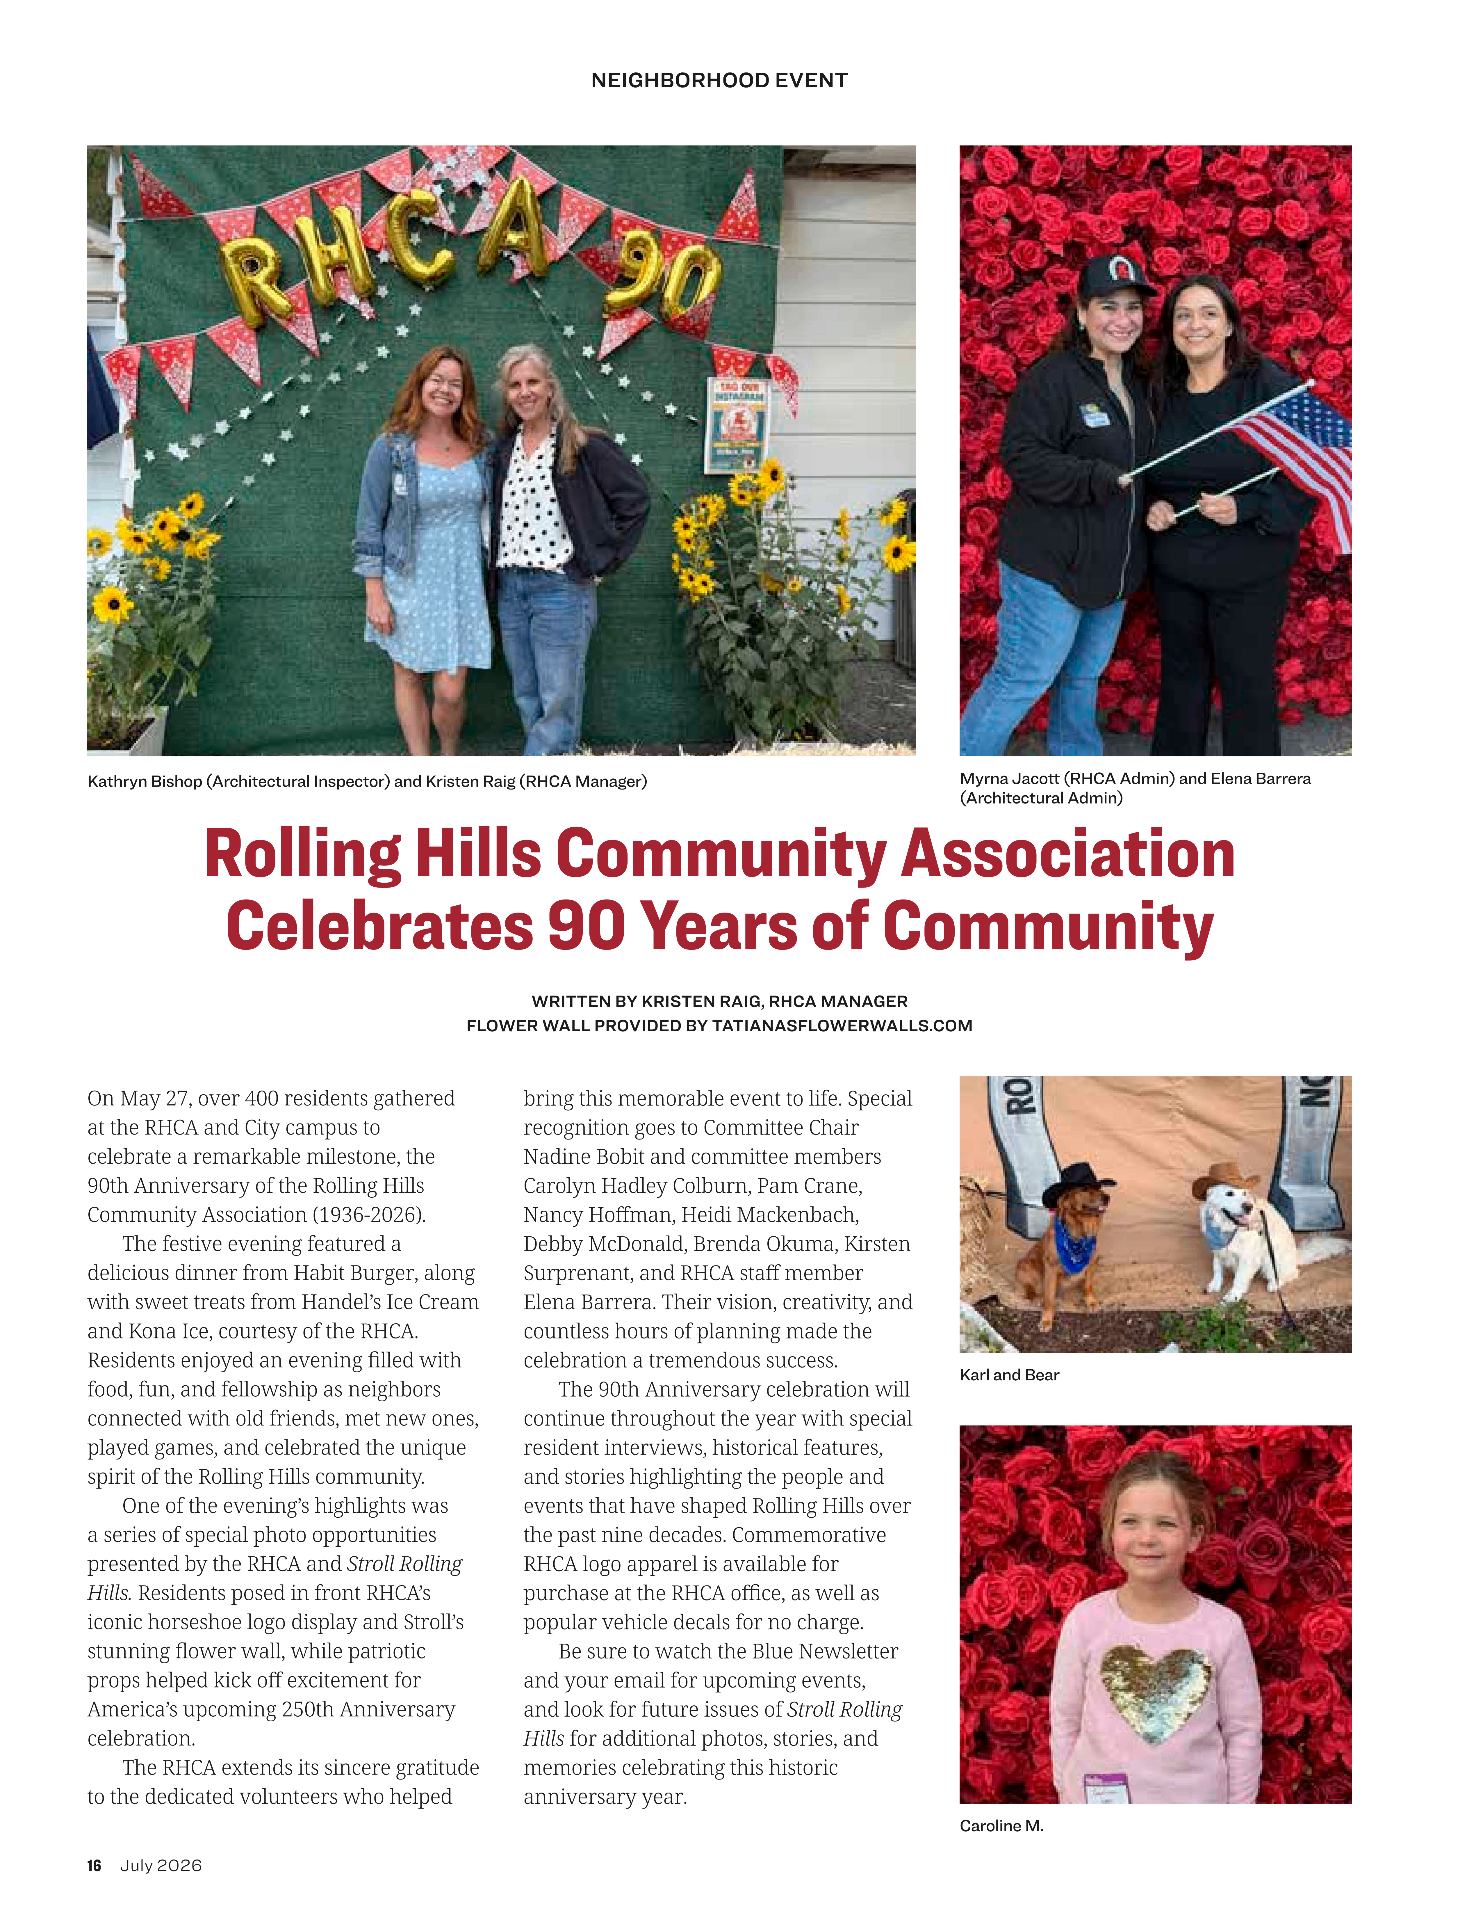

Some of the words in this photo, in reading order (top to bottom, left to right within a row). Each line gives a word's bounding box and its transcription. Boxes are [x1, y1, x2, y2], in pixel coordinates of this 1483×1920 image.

[593, 72, 769, 88] NEIGHBORHOOD
[776, 73, 848, 87] EVENT
[220, 174, 549, 329] RHCA
[602, 230, 724, 320] 90
[89, 775, 147, 790] Kathryn
[152, 775, 202, 790] Bishop
[207, 773, 309, 790] (Architectural
[315, 774, 390, 790] Inspector)
[395, 775, 421, 787] and
[427, 775, 478, 787] Kristen
[484, 775, 515, 790] Raig
[520, 774, 571, 790] (RHCA
[576, 774, 647, 790] Manager)
[961, 773, 1008, 787] Myrna
[1012, 773, 1060, 784] Jacott
[1064, 771, 1116, 787] (RHCA
[1120, 771, 1175, 787] Admin)
[1180, 772, 1206, 784] and
[1212, 772, 1252, 784] Elena
[1257, 773, 1311, 784] Barrera
[961, 790, 1063, 806] (Architectural
[1068, 790, 1122, 806] Admin)
[207, 826, 401, 888] Rolling
[418, 826, 541, 877] Hills
[558, 827, 887, 888] Community
[901, 827, 1234, 877] Association
[228, 898, 533, 950] Celebrates
[549, 899, 624, 950] 90
[640, 900, 797, 950] Years
[813, 898, 869, 950] of
[885, 899, 1214, 961] Community
[532, 996, 610, 1007] WRITTEN
[616, 996, 637, 1007] BY
[643, 995, 714, 1007] KRISTEN
[721, 995, 764, 1010] RAIG,
[770, 995, 816, 1007] RHCA
[822, 995, 907, 1007] MANAGER
[468, 1020, 537, 1032] FLOWER
[543, 1020, 590, 1031] WALL
[595, 1020, 681, 1032] PROVIDED
[687, 1020, 708, 1031] BY
[712, 1020, 972, 1032] TATIANASFLOWERWALLS.COM
[88, 1090, 114, 1106] On
[121, 1091, 161, 1110] May
[167, 1090, 192, 1108] 27,
[199, 1094, 240, 1106] over
[245, 1090, 278, 1106] 400
[285, 1090, 367, 1106] residents
[374, 1090, 455, 1110] gathered
[524, 1119, 629, 1140] recognition
[635, 1123, 675, 1140] goes
[681, 1121, 697, 1135] to
[704, 1119, 803, 1135] Committee
[810, 1119, 859, 1135] Chair
[88, 1177, 129, 1193] 90th
[134, 1177, 249, 1198] Anniversary
[256, 1177, 275, 1193] of
[279, 1177, 307, 1193] the
[313, 1177, 377, 1198] Rolling
[383, 1177, 424, 1193] Hills
[524, 1207, 583, 1227] Nancy
[589, 1206, 675, 1225] Hoffman,
[682, 1206, 732, 1222] Heidi
[737, 1206, 858, 1225] Mackenbach,
[88, 1264, 169, 1280] delicious
[176, 1264, 237, 1280] dinner
[243, 1264, 288, 1280] from
[294, 1264, 344, 1280] Habit
[351, 1265, 418, 1285] Burger,
[425, 1264, 475, 1285] along
[524, 1293, 575, 1309] Elena
[582, 1294, 655, 1309] Barrera.
[662, 1293, 711, 1309] Their
[717, 1294, 776, 1312] vision,
[783, 1294, 871, 1314] creativity,
[878, 1293, 913, 1309] and
[89, 1352, 175, 1368] Residents
[182, 1352, 253, 1372] enjoyed
[260, 1356, 281, 1368] an
[289, 1352, 362, 1372] evening
[368, 1351, 413, 1368] filled
[419, 1352, 460, 1368] with
[961, 1369, 989, 1381] Karl
[994, 1369, 1020, 1381] and
[1026, 1369, 1060, 1381] Bear
[559, 1381, 592, 1397] The
[599, 1381, 639, 1397] 90th
[645, 1381, 761, 1402] Anniversary
[767, 1381, 869, 1397] celebration
[875, 1381, 910, 1397] will
[88, 1439, 149, 1460] played
[155, 1443, 217, 1460] games,
[224, 1439, 259, 1455] and
[265, 1439, 360, 1455] celebrated
[366, 1439, 394, 1455] the
[401, 1439, 466, 1460] unique
[524, 1468, 559, 1484] and
[565, 1468, 624, 1484] stories
[630, 1468, 742, 1489] highlighting
[748, 1468, 776, 1484] the
[782, 1468, 843, 1489] people
[850, 1468, 884, 1484] and
[88, 1531, 97, 1542] a
[104, 1526, 156, 1542] series
[163, 1526, 181, 1542] of
[186, 1526, 248, 1547] special
[253, 1526, 306, 1547] photo
[313, 1526, 436, 1547] opportunities
[524, 1556, 578, 1571] RHCA
[583, 1555, 621, 1576] logo
[628, 1555, 698, 1576] apparel
[703, 1556, 717, 1571] is
[724, 1555, 806, 1571] available
[812, 1555, 839, 1571] for
[88, 1614, 142, 1629] iconic
[148, 1613, 241, 1629] horseshoe
[247, 1613, 285, 1634] logo
[292, 1613, 358, 1634] display
[363, 1613, 398, 1629] and
[404, 1613, 463, 1629] Stroll’s
[559, 1644, 581, 1659] Be
[588, 1647, 626, 1659] sure
[633, 1645, 649, 1659] to
[655, 1643, 712, 1659] watch
[718, 1643, 746, 1659] the
[753, 1643, 793, 1659] Blue
[800, 1643, 899, 1659] Newsletter
[88, 1701, 177, 1717] America’s
[183, 1701, 276, 1721] upcoming
[283, 1701, 333, 1717] 250th
[341, 1701, 456, 1721] Anniversary
[523, 1730, 564, 1746] Hills
[570, 1730, 597, 1746] for
[603, 1730, 696, 1746] additional
[701, 1730, 767, 1751] photos,
[774, 1730, 837, 1749] stories,
[844, 1730, 878, 1746] and
[88, 1790, 104, 1804] to
[110, 1788, 139, 1804] the
[146, 1788, 234, 1804] dedicated
[240, 1788, 337, 1804] volunteers
[344, 1788, 383, 1804] who
[390, 1788, 452, 1809] helped
[961, 1819, 1021, 1832] Caroline
[1026, 1820, 1043, 1831] M.
[88, 1859, 101, 1871] 16
[121, 1859, 152, 1874] July
[158, 1859, 201, 1871] 2026
